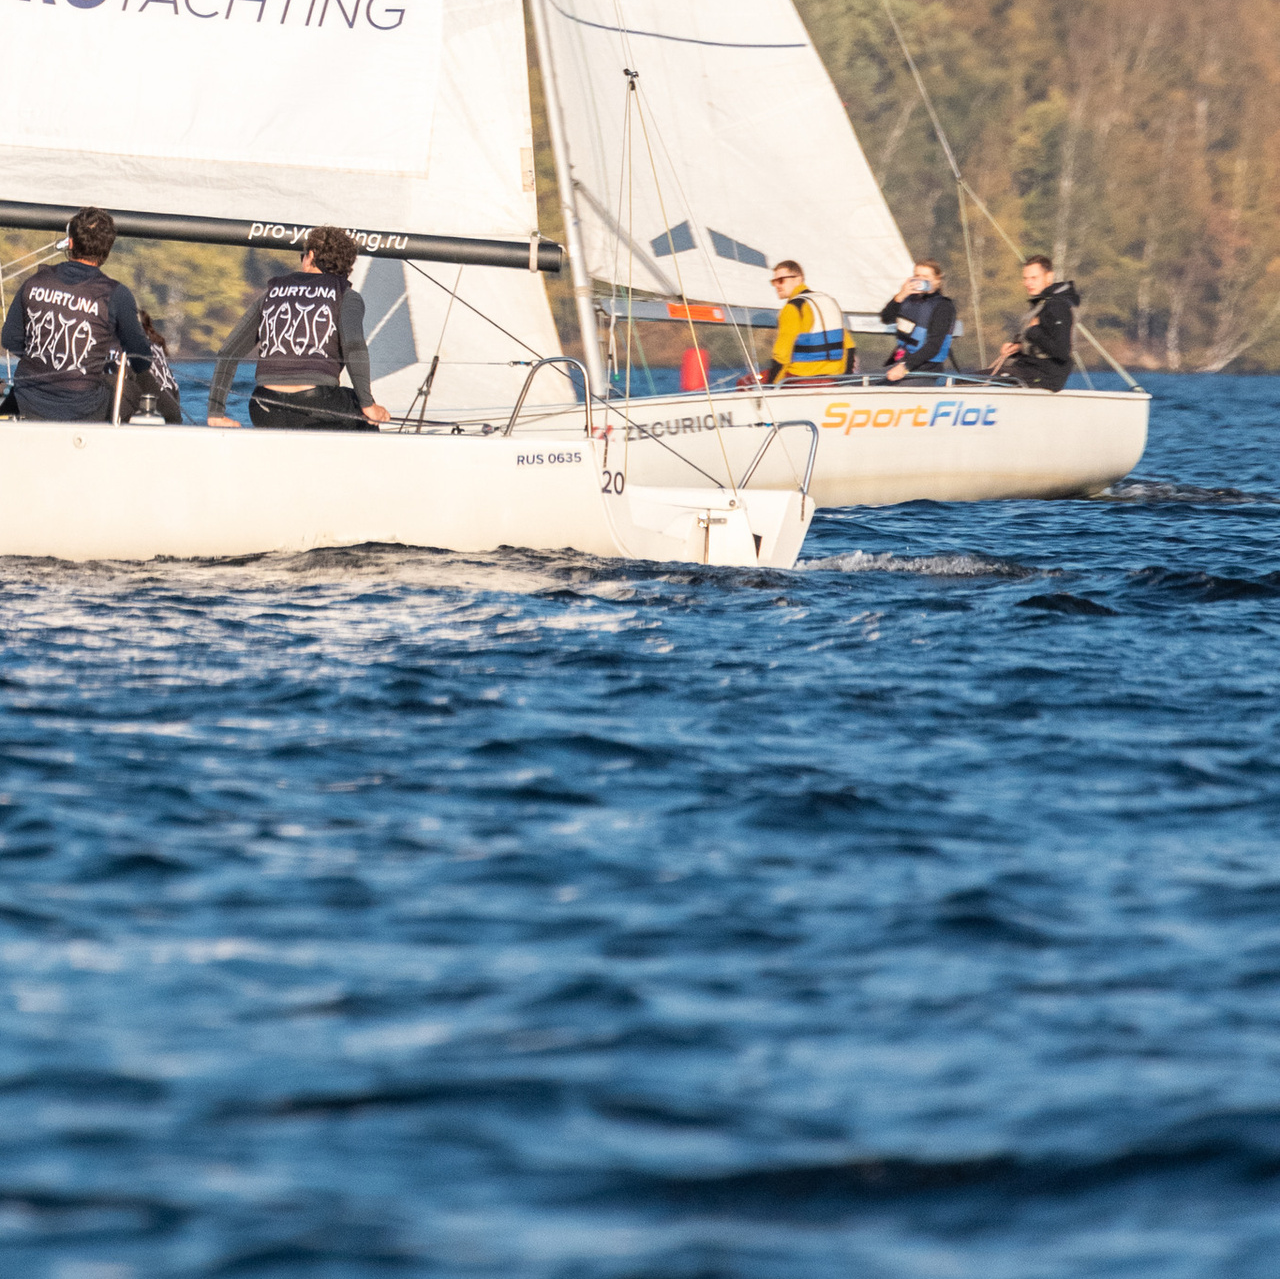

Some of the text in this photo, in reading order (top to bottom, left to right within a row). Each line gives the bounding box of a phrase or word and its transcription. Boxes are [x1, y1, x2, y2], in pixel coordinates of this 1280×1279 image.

[248, 222, 409, 252] pro-ying.ru
[29, 287, 99, 317] FOURTUNA
[265, 285, 336, 302] OURTUNA
[623, 411, 733, 442] ZECURION
[517, 452, 582, 466] RUS 0635
[601, 470, 625, 495] 20
